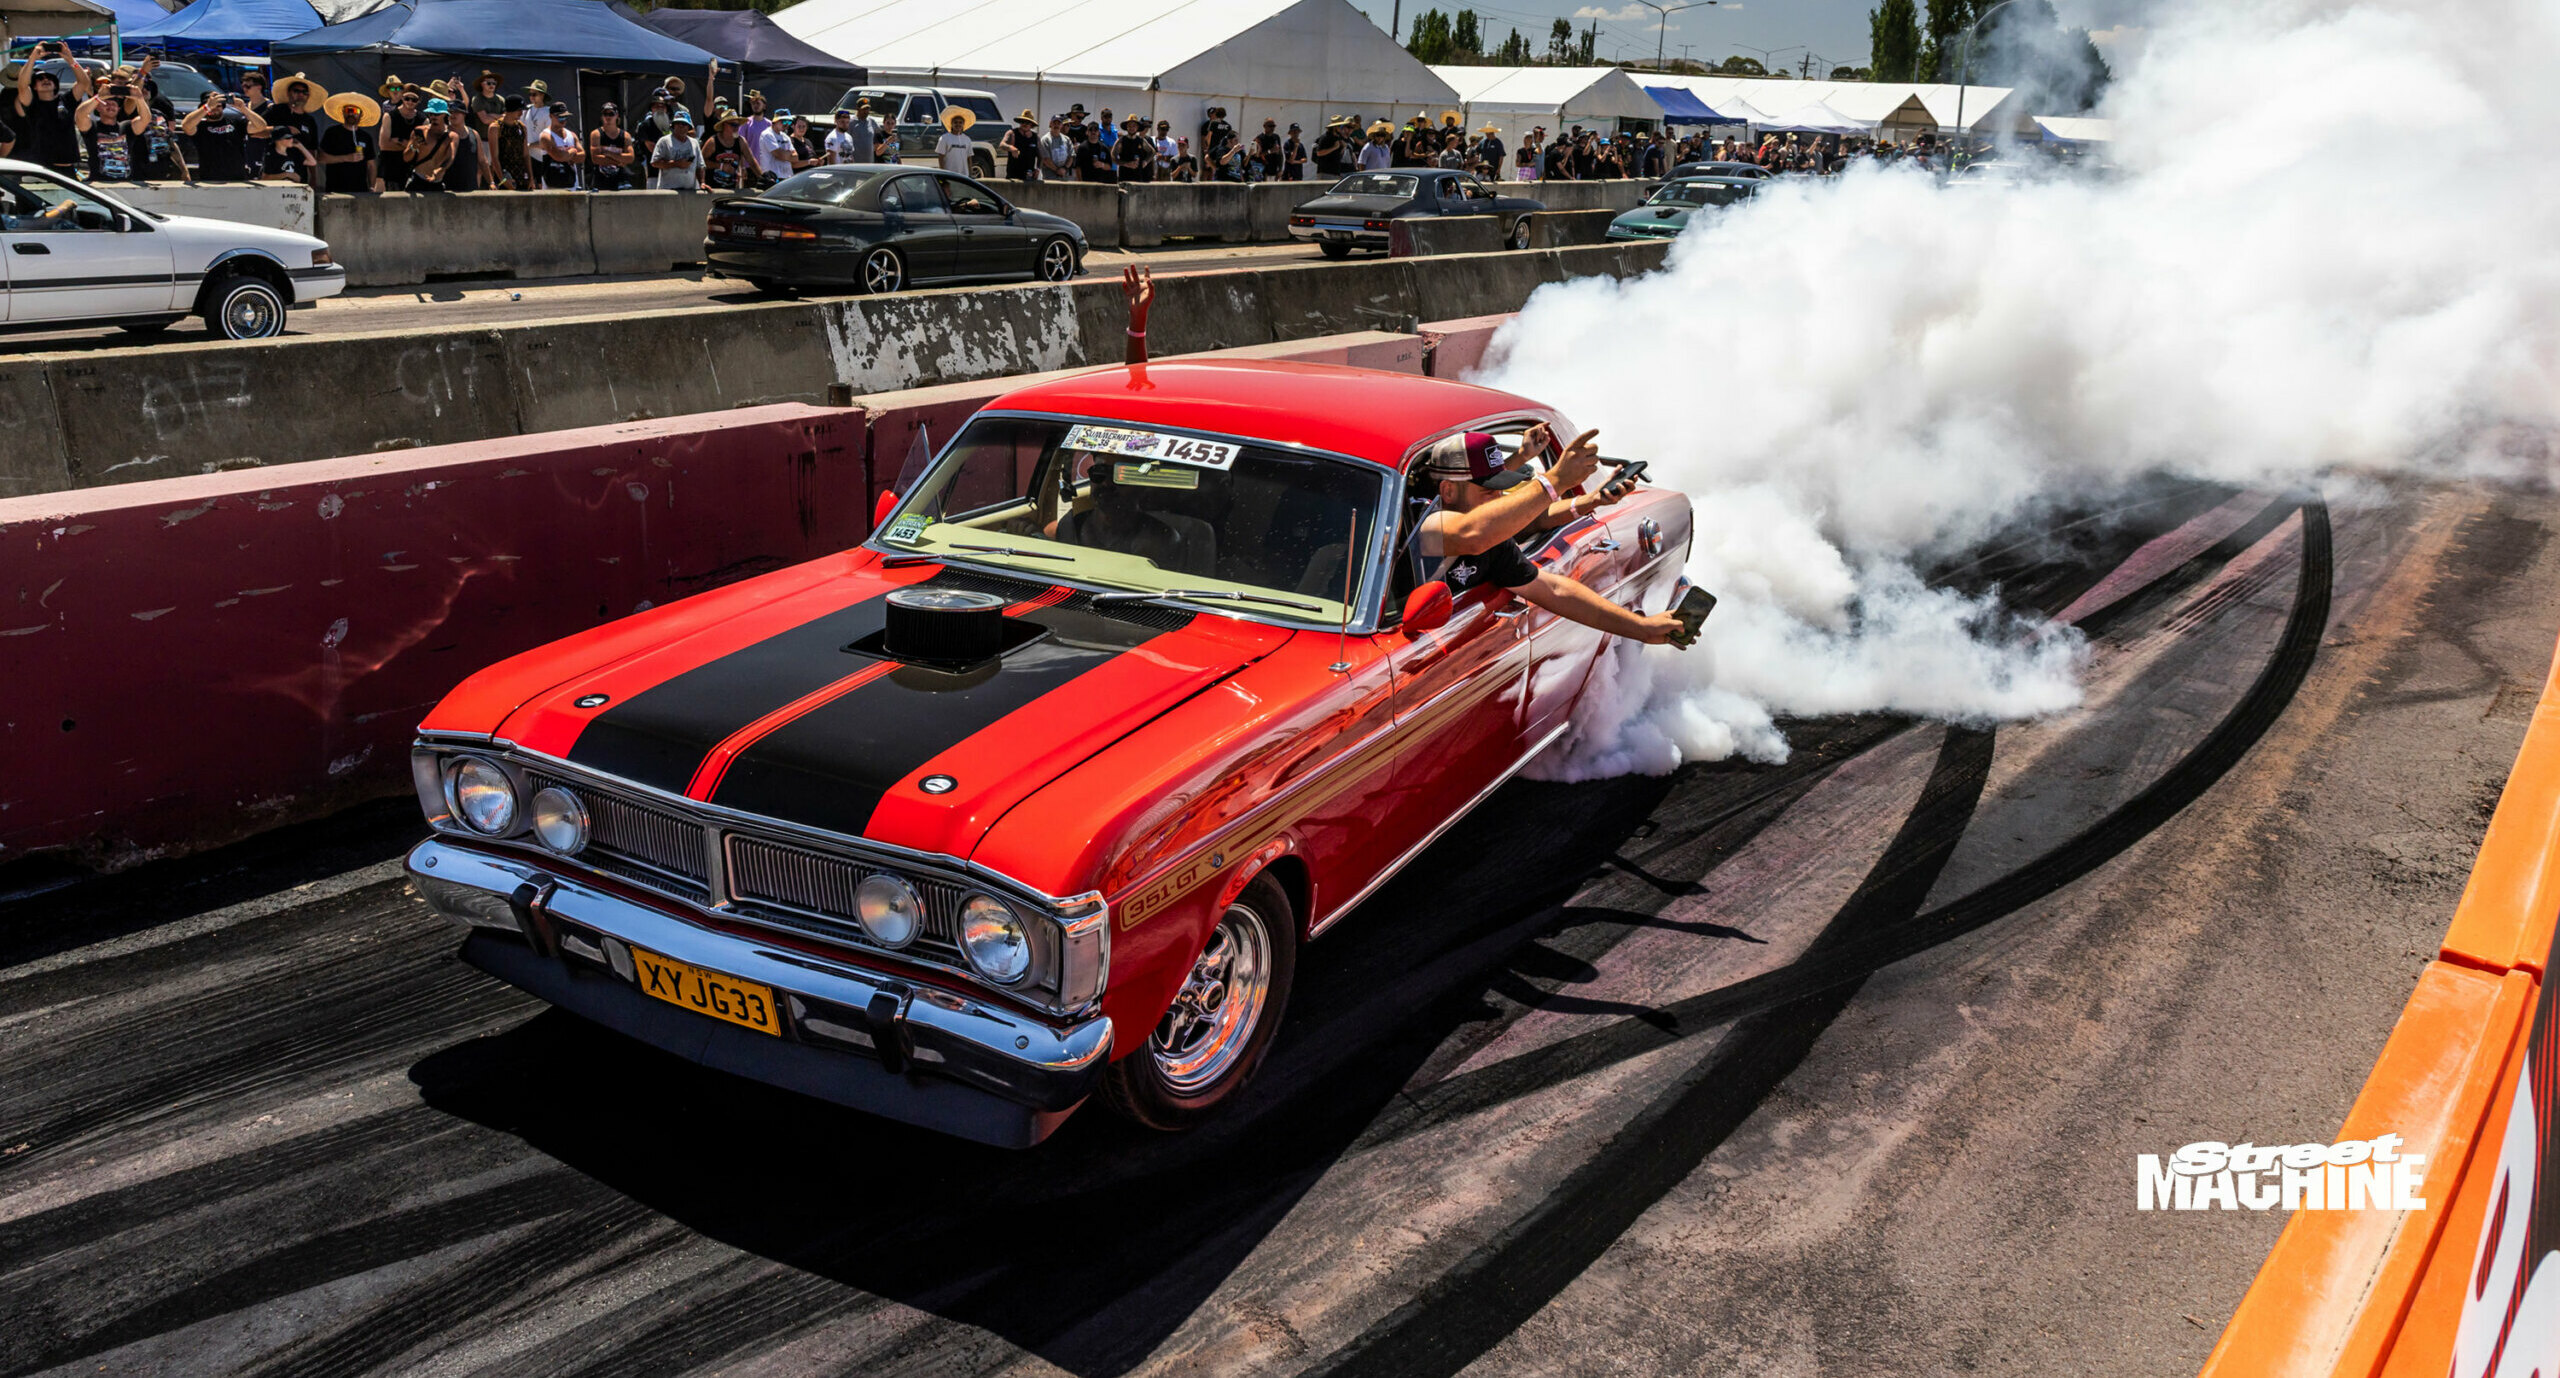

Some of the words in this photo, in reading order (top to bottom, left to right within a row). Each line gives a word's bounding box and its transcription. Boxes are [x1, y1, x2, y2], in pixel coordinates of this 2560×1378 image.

[1082, 428, 1135, 442] SUMMERNATS
[1163, 439, 1230, 465] 1453
[891, 528, 916, 539] 1453
[1129, 863, 1201, 919] 351-GT
[688, 966, 712, 979] NSW
[642, 959, 682, 1000] XY
[690, 977, 768, 1026] JG33
